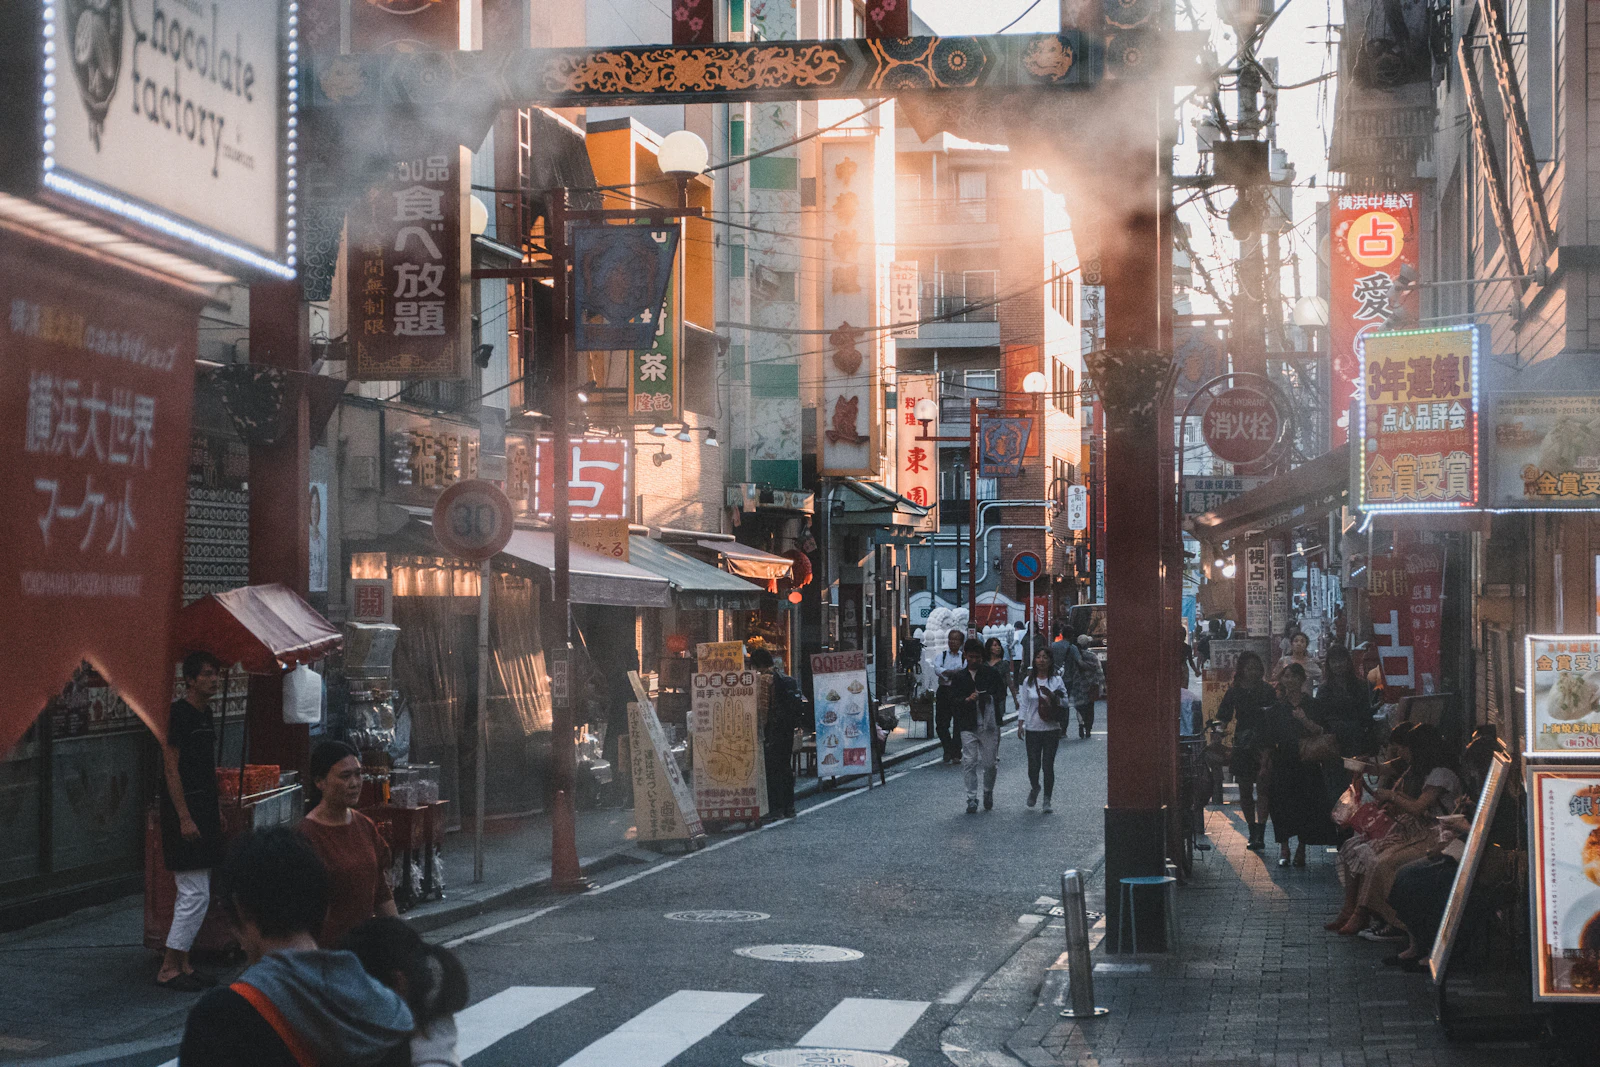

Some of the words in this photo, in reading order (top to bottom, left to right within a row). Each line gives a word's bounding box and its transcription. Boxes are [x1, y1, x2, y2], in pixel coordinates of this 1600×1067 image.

[1338, 193, 1414, 210] 横浜中華街
[1358, 214, 1396, 258] 占
[393, 185, 446, 337] 食べ放題
[24, 370, 156, 469] 横浜大世界
[635, 393, 672, 412] 隆記
[1382, 401, 1467, 433] 点心品評会
[1209, 411, 1273, 440] 消火栓
[1366, 451, 1472, 502] 金賞受賞
[34, 474, 137, 556] マーケット
[453, 503, 496, 537] 30
[1248, 541, 1266, 581] 視占
[1536, 654, 1600, 671] 金賞受
[1569, 795, 1600, 817] 銀
